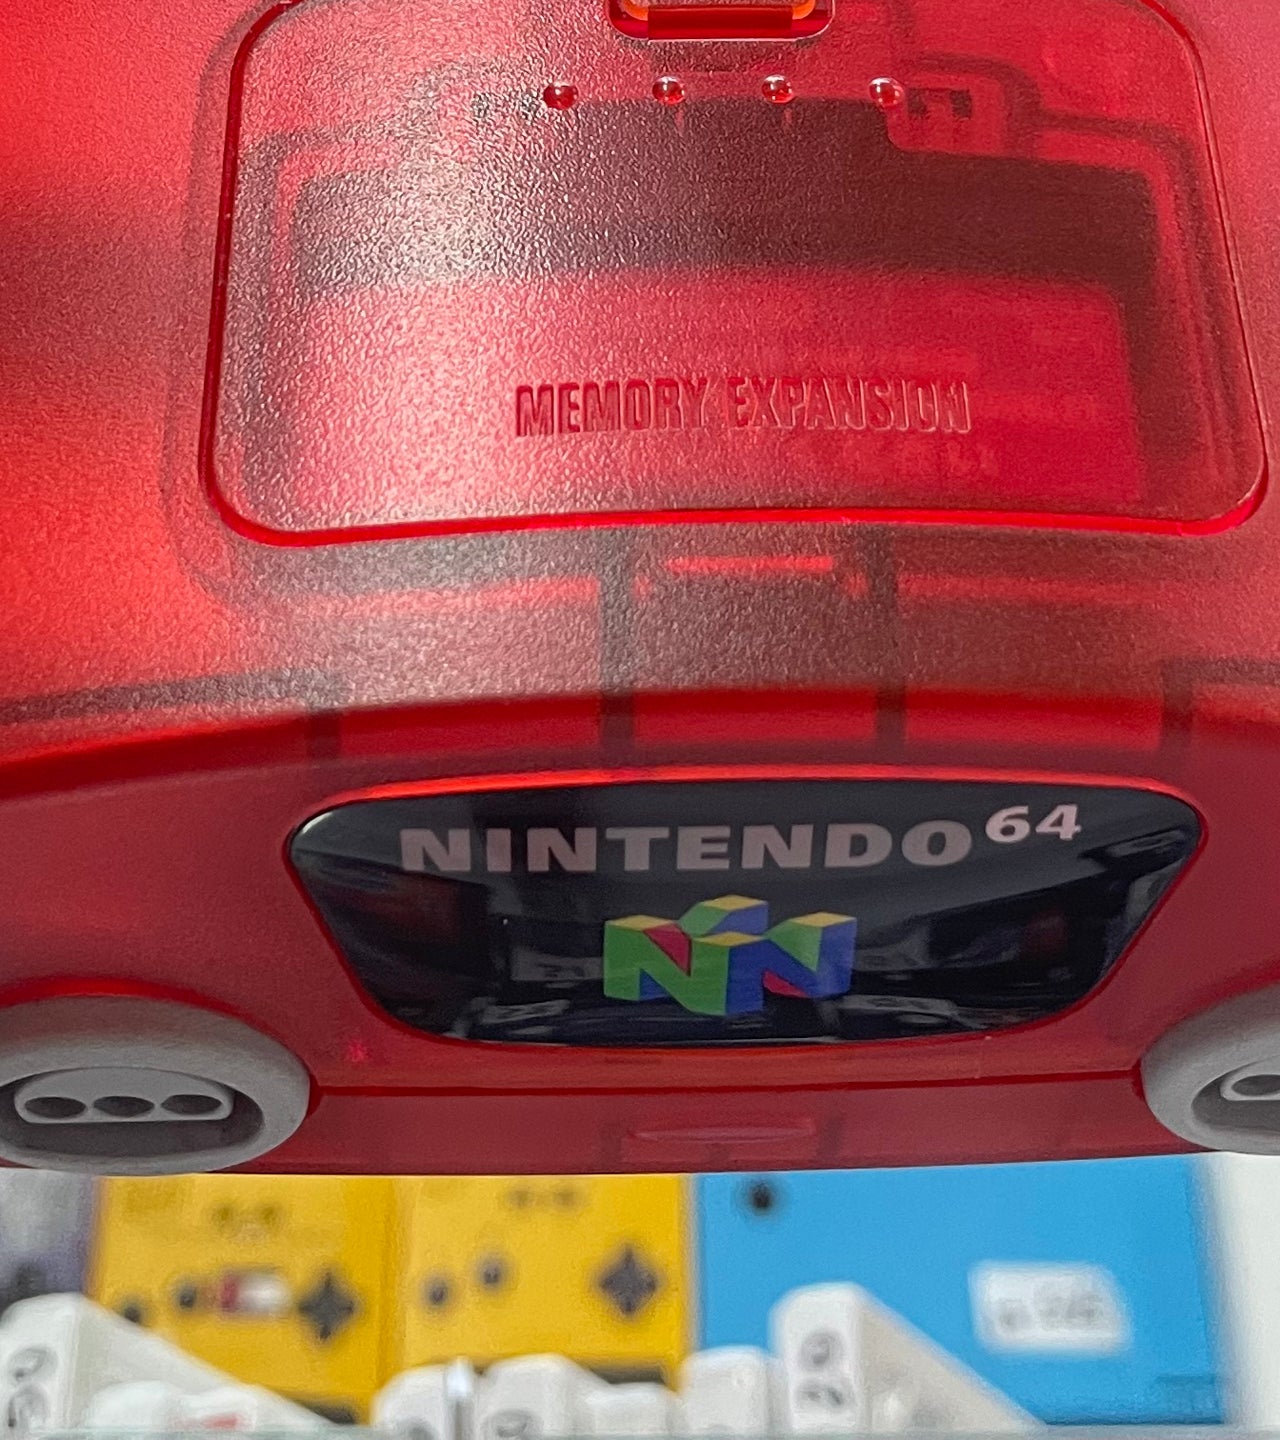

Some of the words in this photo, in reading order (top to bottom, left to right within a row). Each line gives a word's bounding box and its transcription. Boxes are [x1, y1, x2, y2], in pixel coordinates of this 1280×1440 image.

[515, 377, 708, 437] MEMORY
[723, 375, 972, 435] EXPANSION
[399, 820, 972, 873] NINTENDO
[984, 803, 1083, 844] 64
